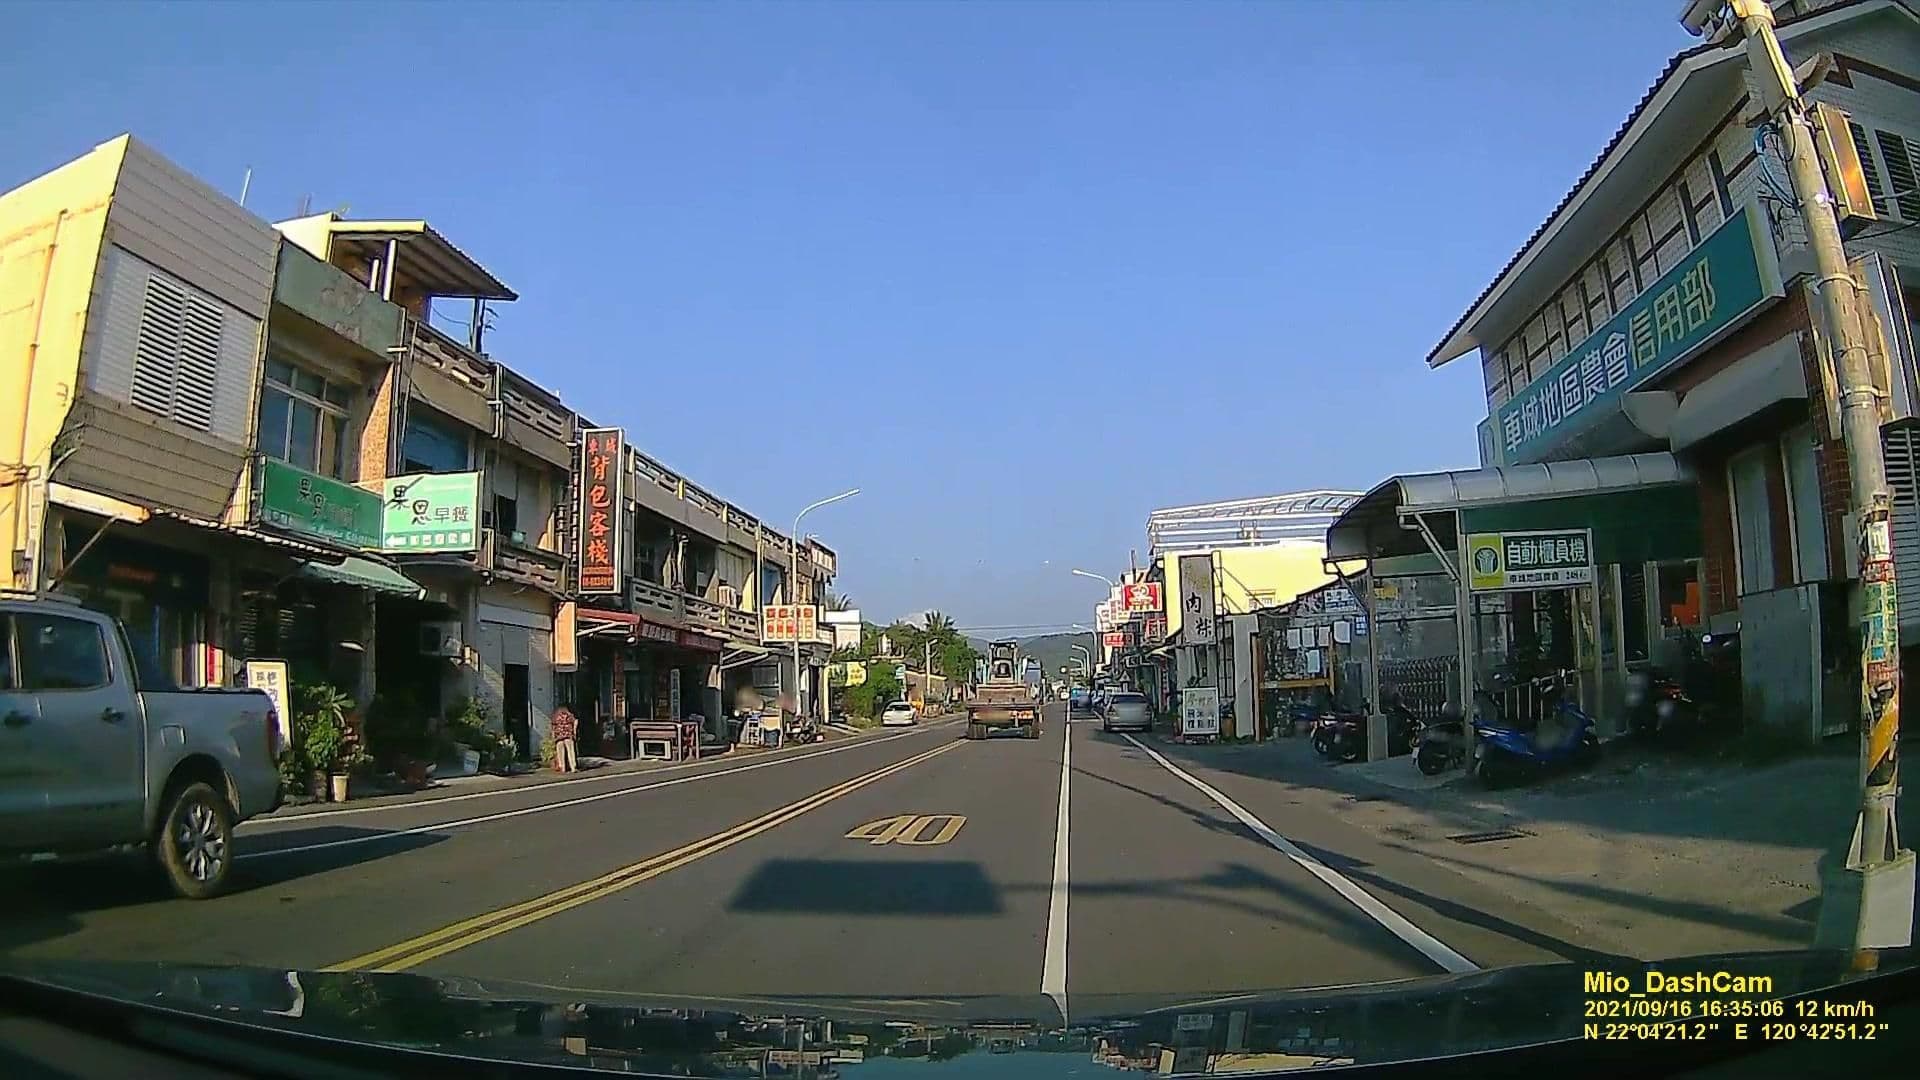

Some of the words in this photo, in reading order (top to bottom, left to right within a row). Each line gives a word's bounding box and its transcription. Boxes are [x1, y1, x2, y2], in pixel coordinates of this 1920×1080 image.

[1503, 256, 1716, 453] 車城地區農會信用部
[587, 455, 611, 565] 背包客棧
[1507, 538, 1586, 566] 自動櫃員機
[844, 814, 968, 845] 40
